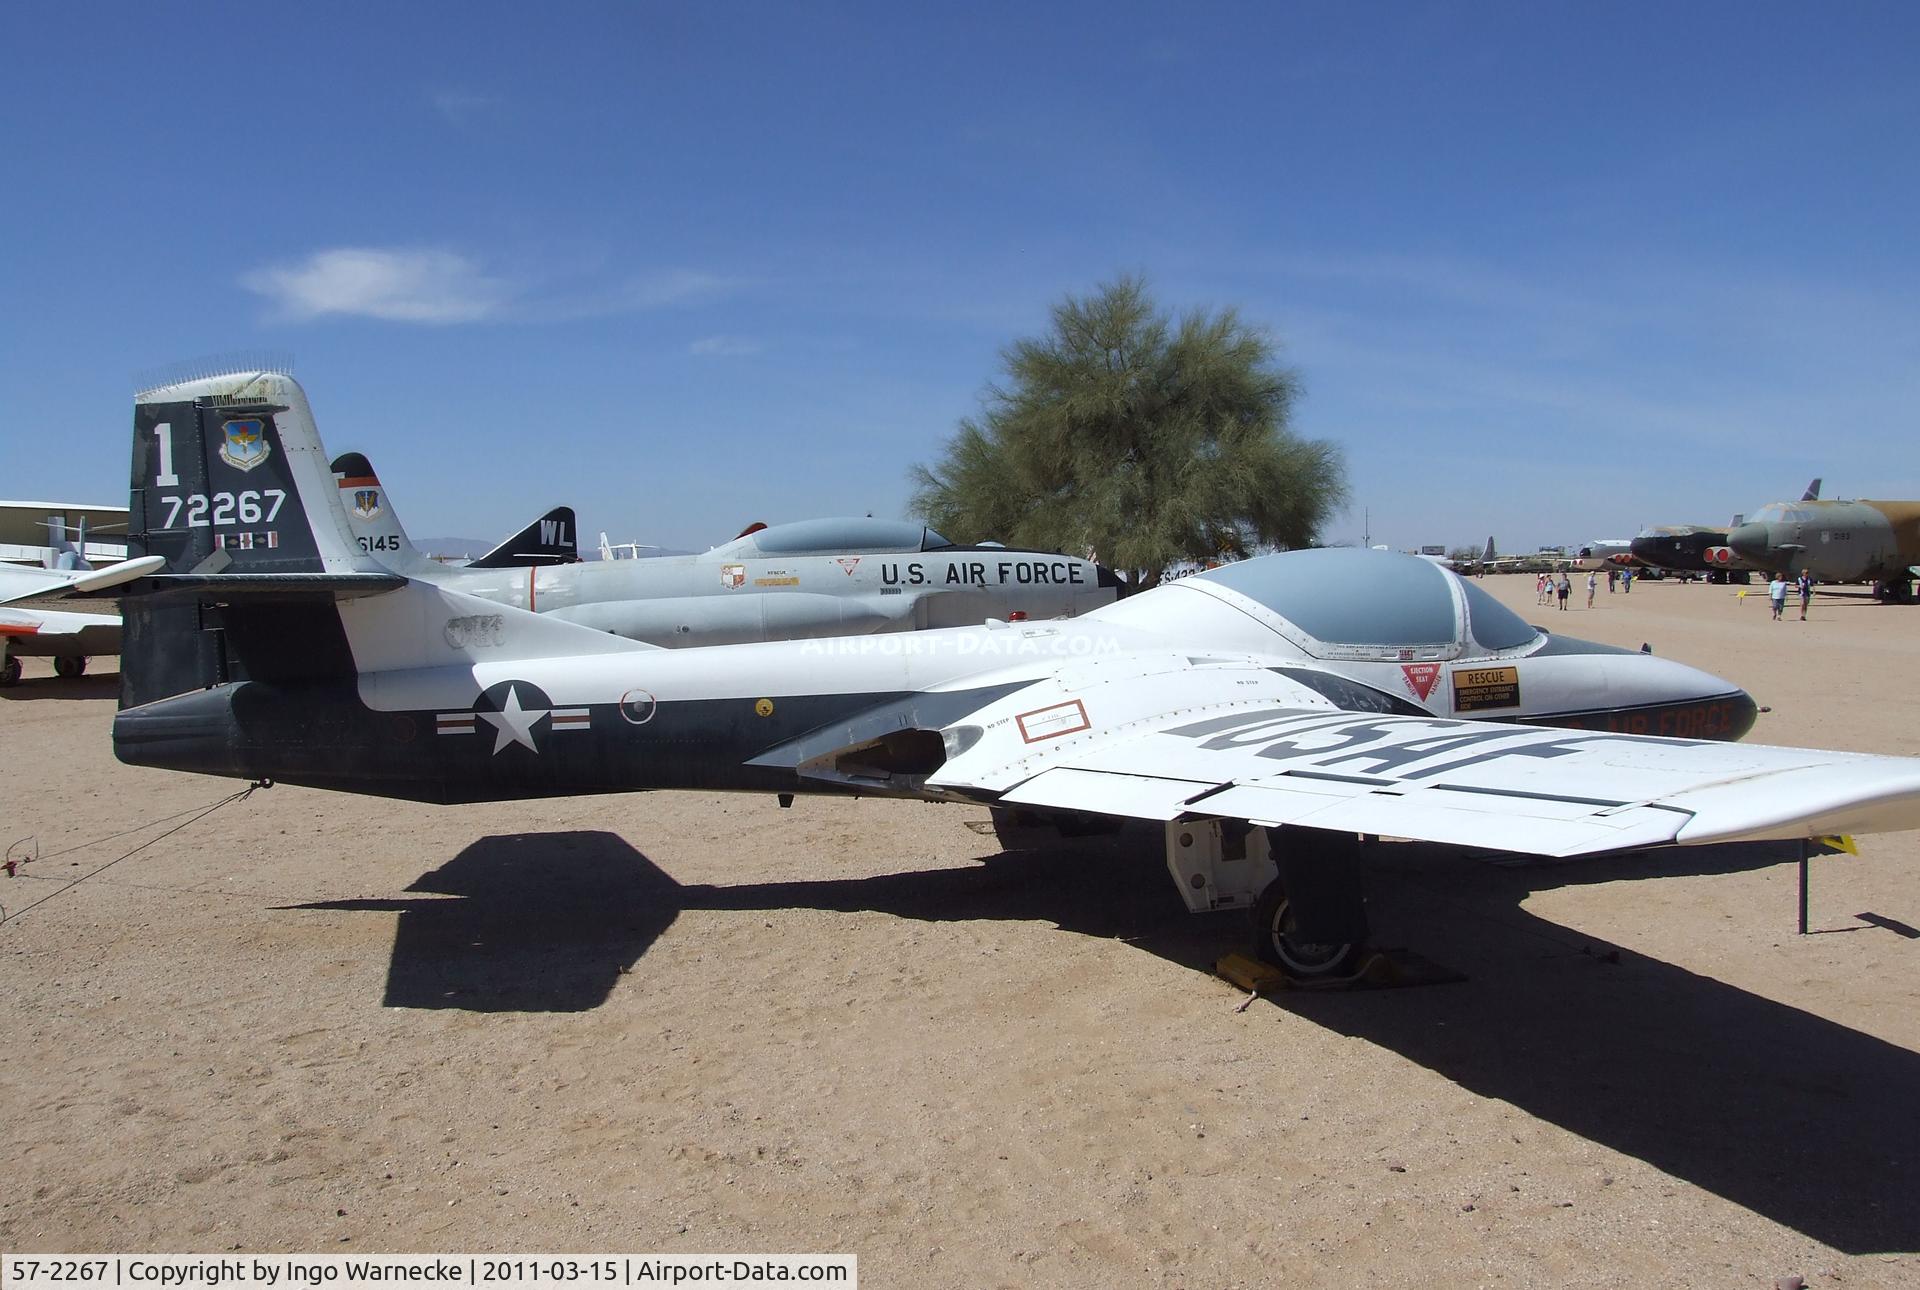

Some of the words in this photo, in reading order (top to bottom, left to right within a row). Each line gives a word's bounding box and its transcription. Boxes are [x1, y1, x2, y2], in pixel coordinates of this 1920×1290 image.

[154, 423, 178, 486] 1
[161, 489, 287, 529] 72267
[540, 520, 574, 547] WL
[881, 563, 932, 585] U.S.
[945, 562, 986, 585] AIR
[998, 562, 1084, 585] FORCE
[1410, 666, 1433, 674] EJECTION
[1468, 671, 1504, 684] RESCUE
[1658, 703, 1734, 738] FORCE
